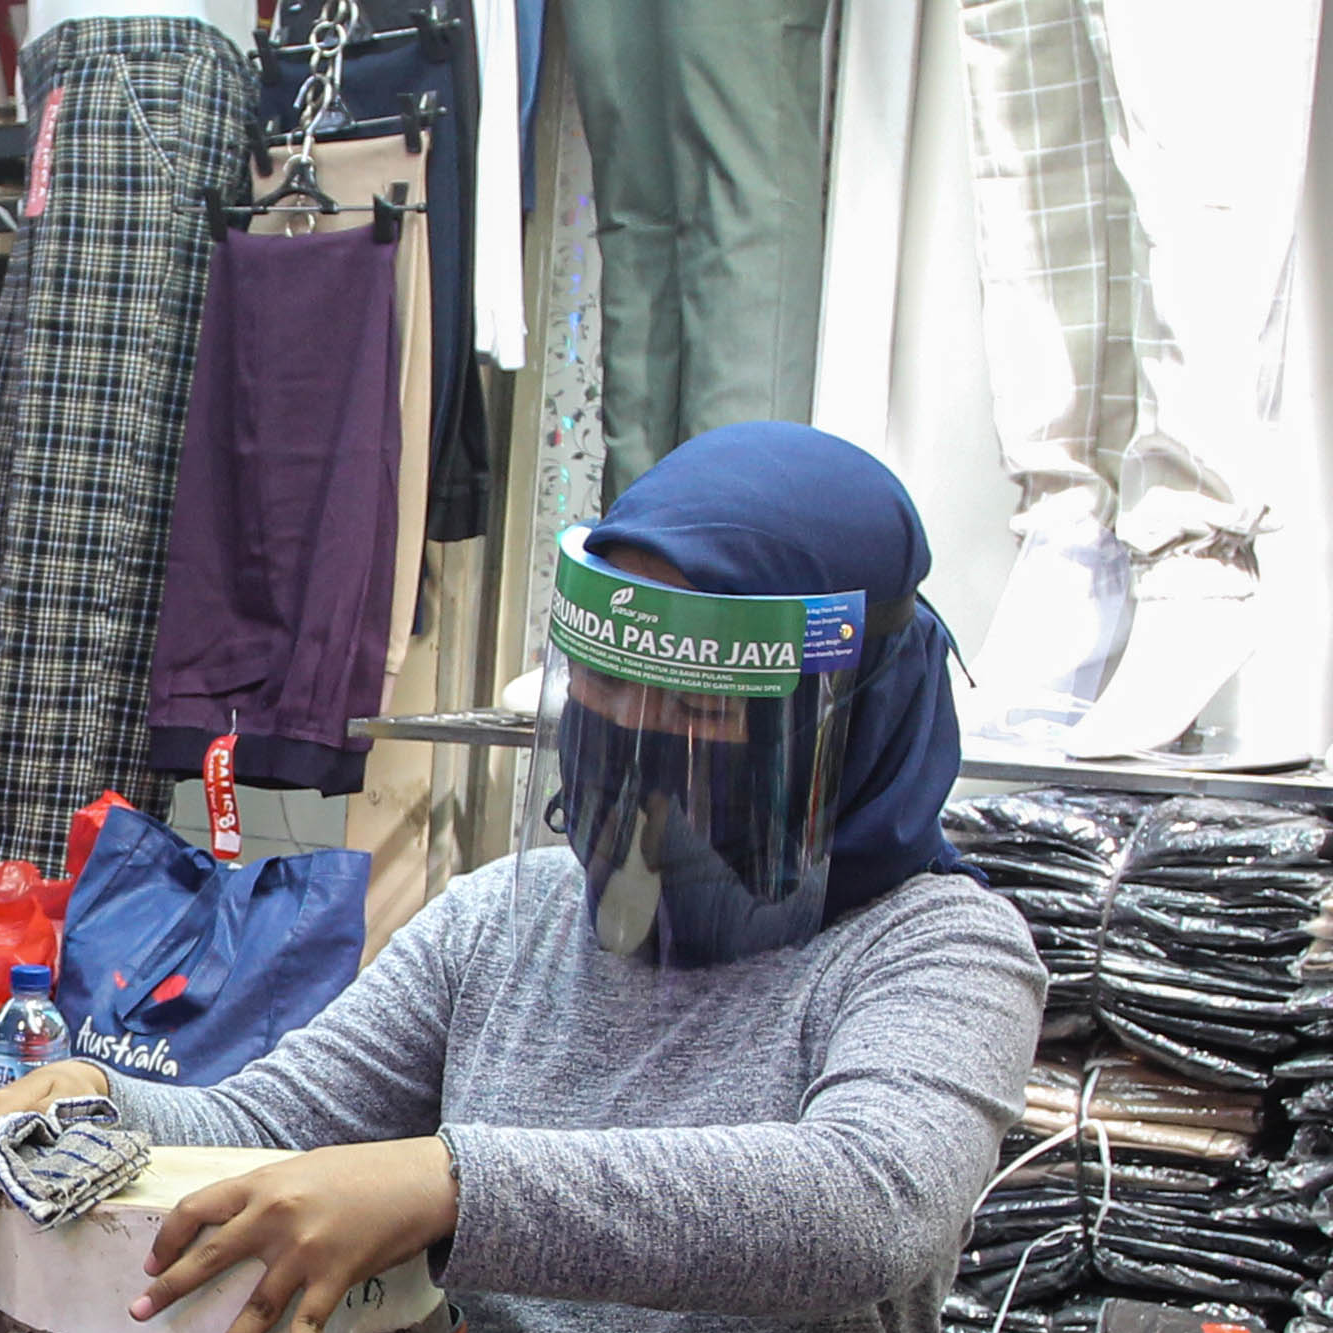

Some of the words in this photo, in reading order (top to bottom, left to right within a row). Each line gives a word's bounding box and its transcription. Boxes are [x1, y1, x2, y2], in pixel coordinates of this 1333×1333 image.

[611, 605, 637, 618] pasar
[636, 611, 660, 624] jaya
[622, 624, 719, 664] PASAR
[724, 641, 797, 666] JAYA
[76, 1015, 178, 1077] Australia
